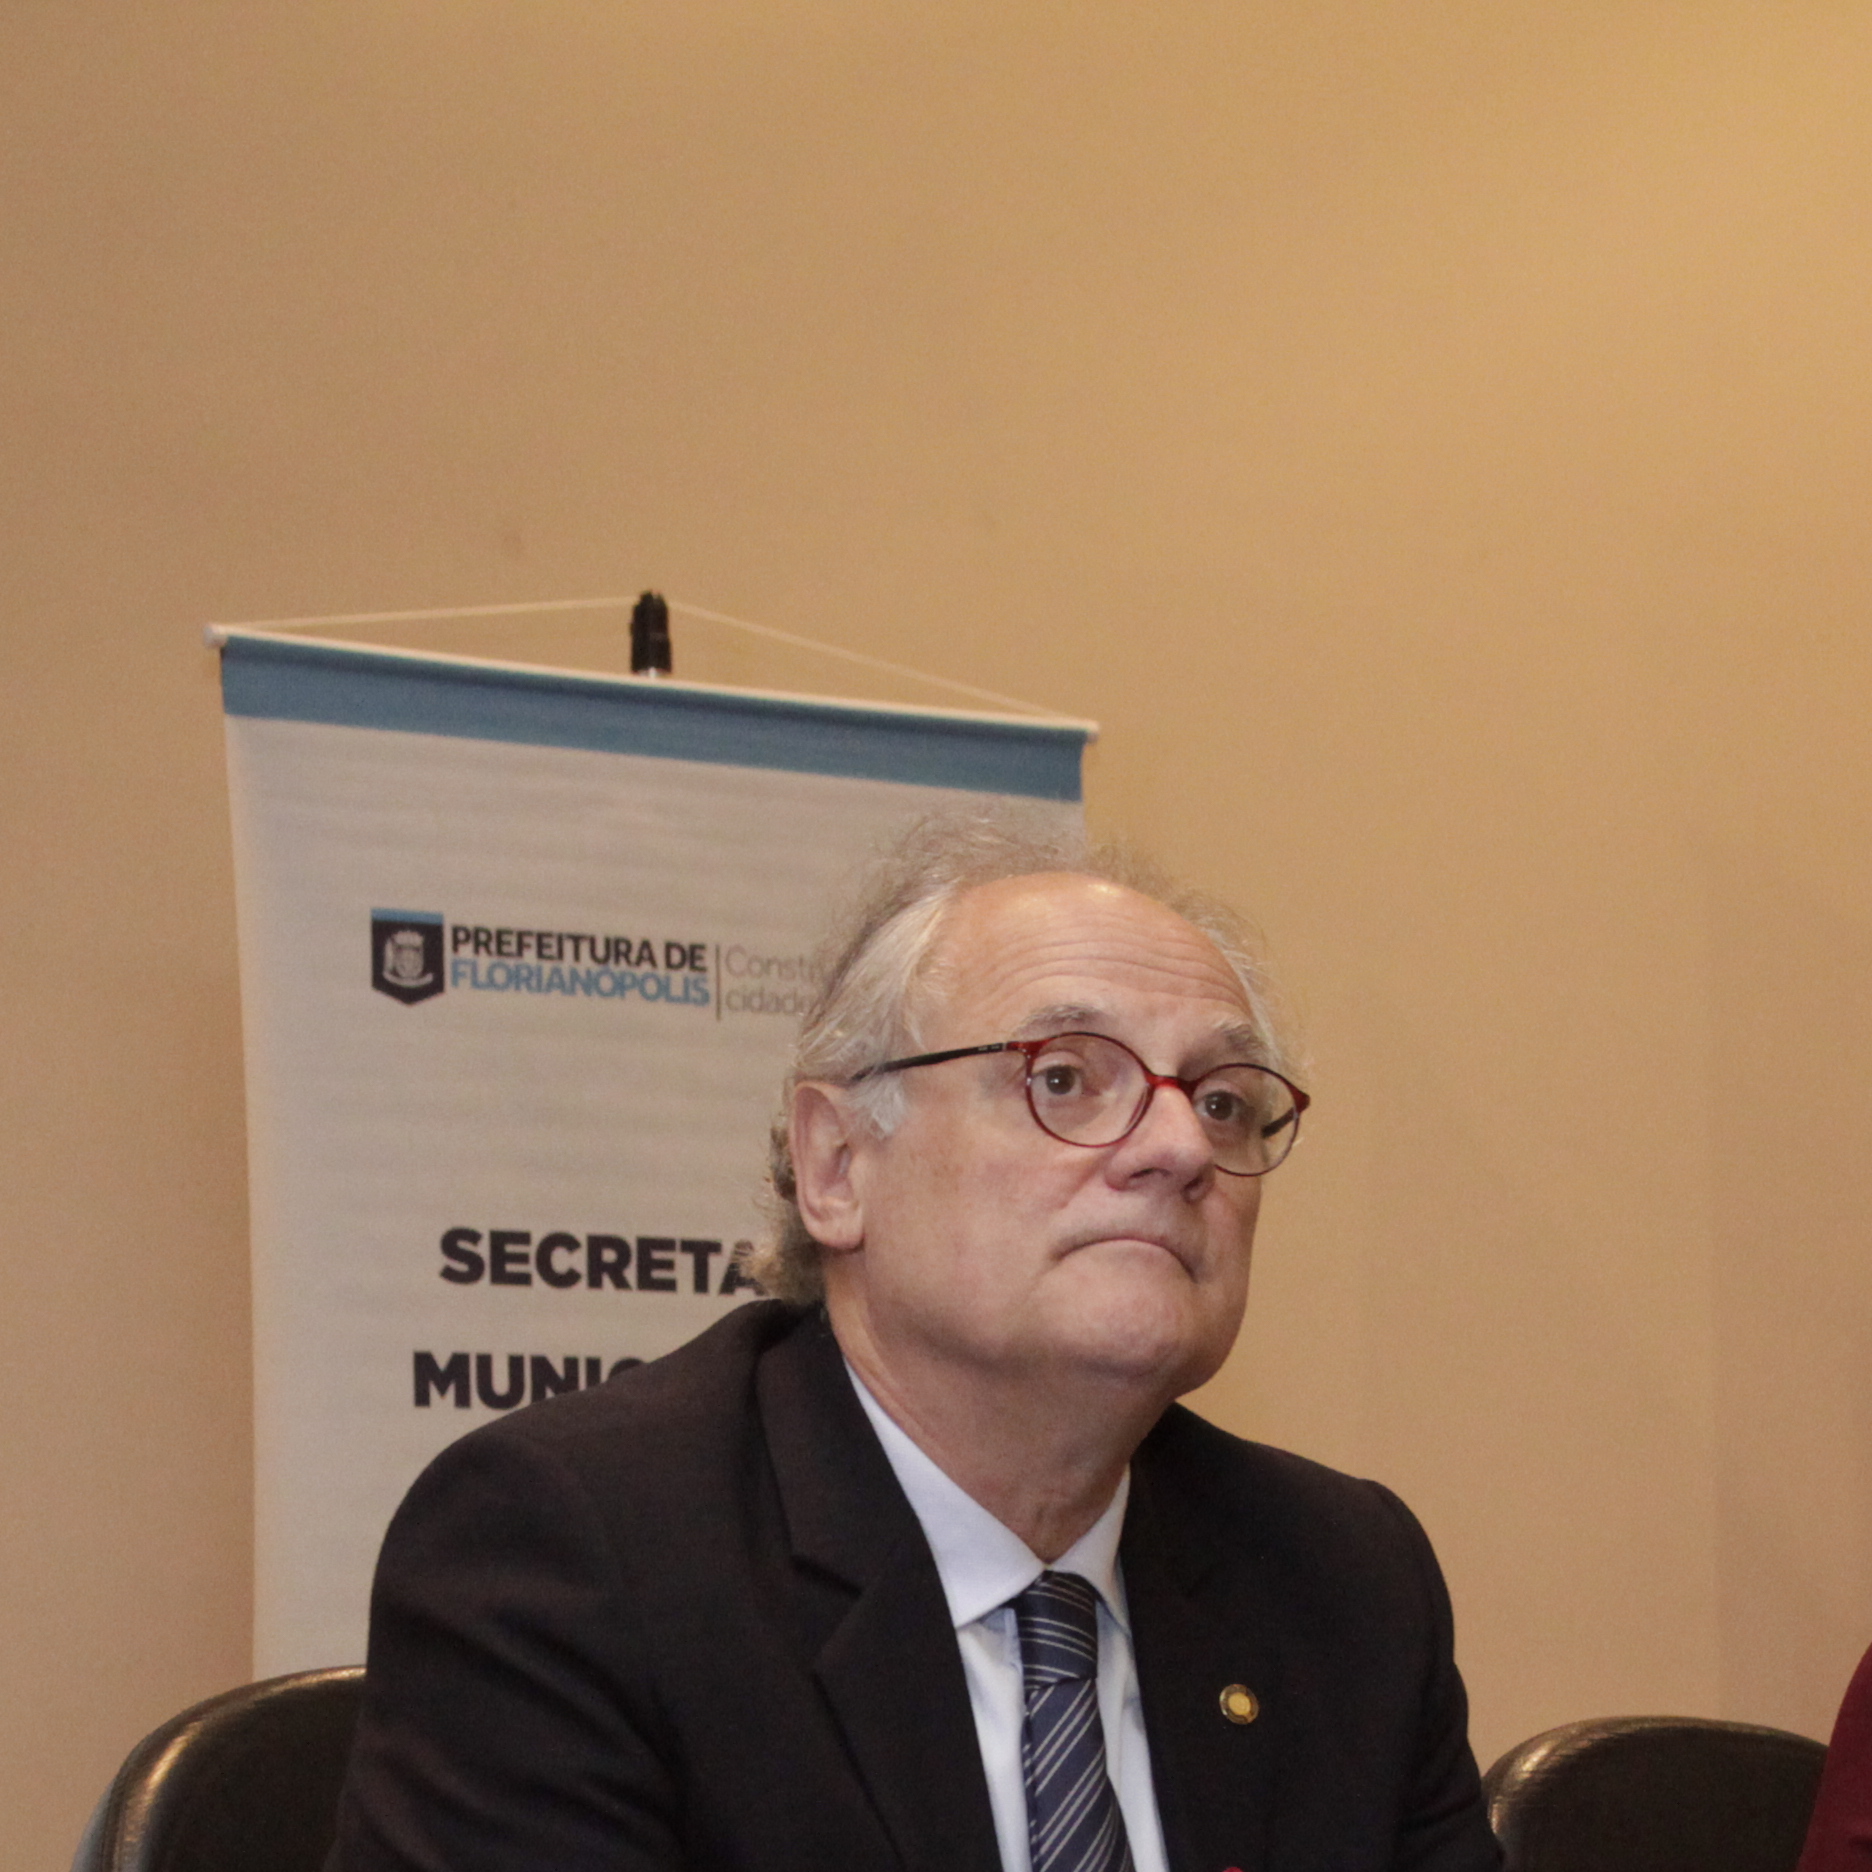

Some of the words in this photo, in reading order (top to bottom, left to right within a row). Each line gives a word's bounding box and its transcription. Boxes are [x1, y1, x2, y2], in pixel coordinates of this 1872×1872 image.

[451, 925, 657, 970] PREFEITURA
[664, 942, 708, 973] DE
[450, 958, 710, 1008] FLORIANÓPOLIS
[413, 1350, 648, 1411] MUNI
